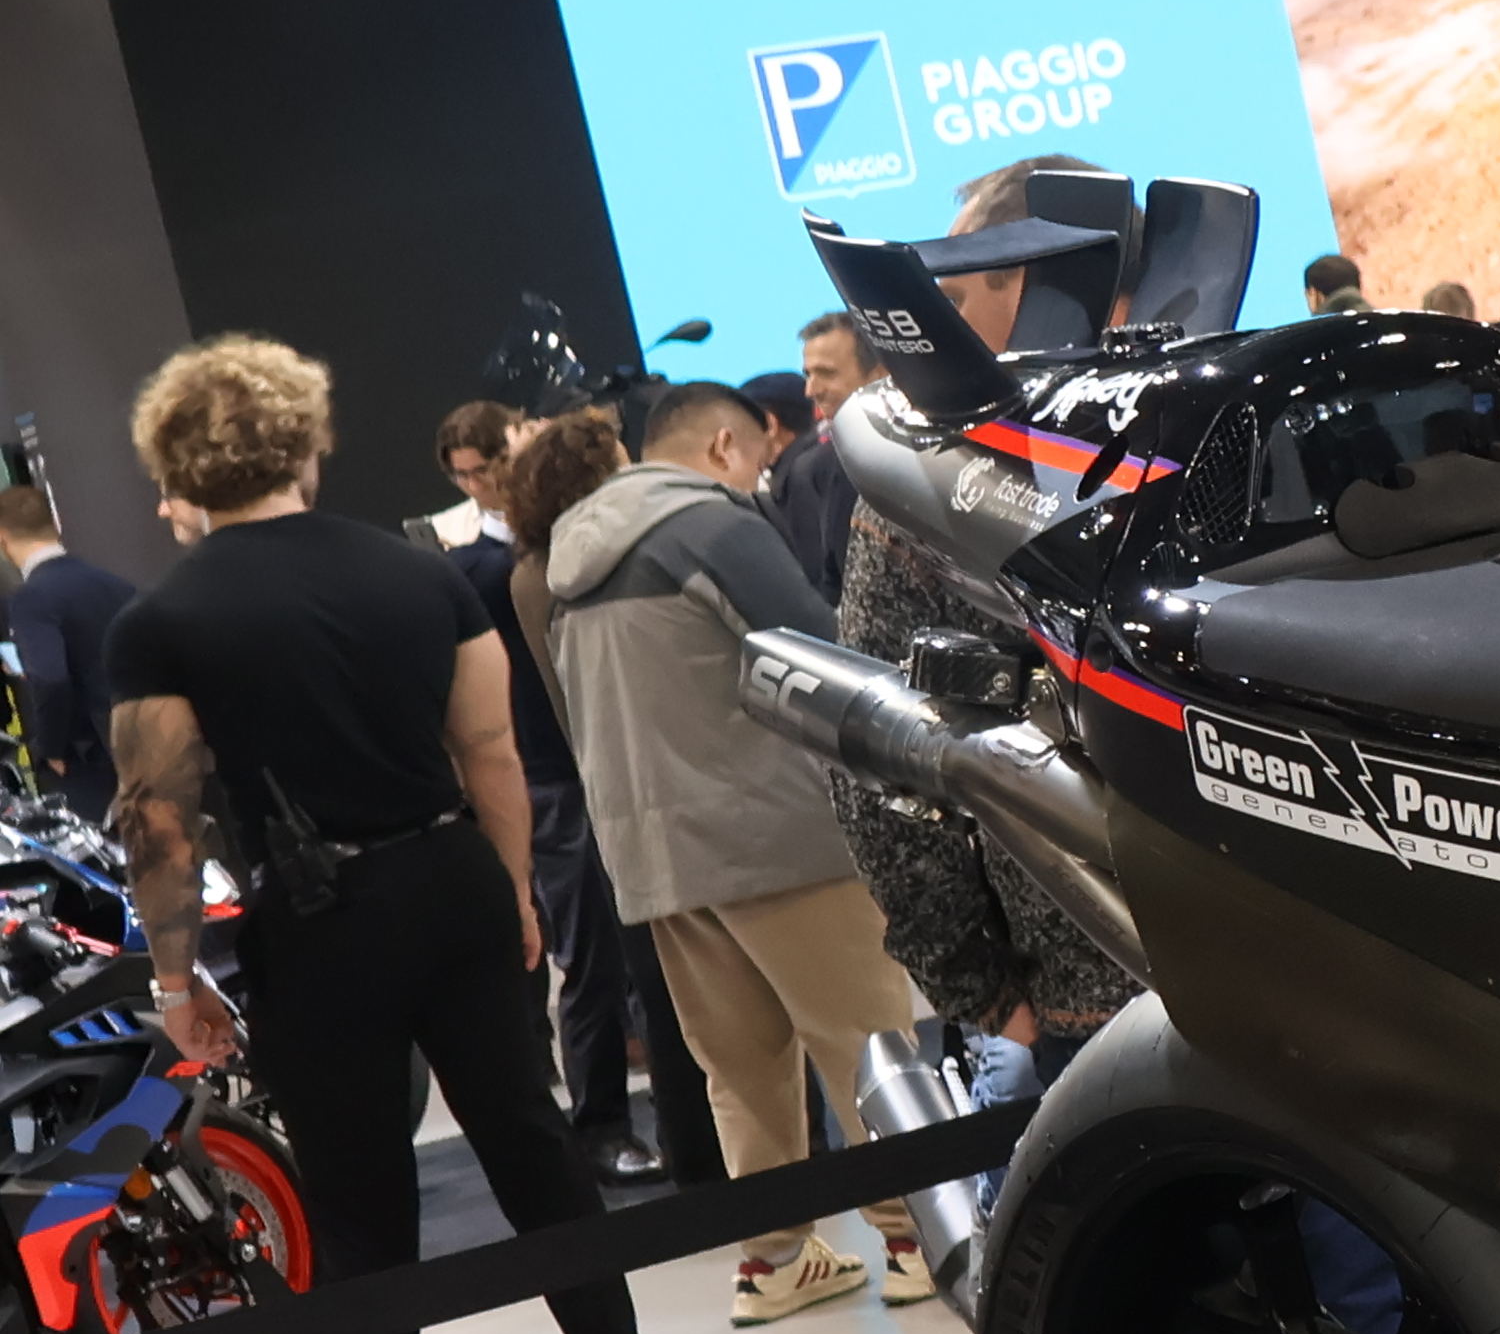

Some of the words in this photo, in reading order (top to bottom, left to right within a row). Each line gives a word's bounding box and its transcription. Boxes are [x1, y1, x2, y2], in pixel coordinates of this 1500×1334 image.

[920, 37, 1127, 104] PIAGGIO
[762, 51, 844, 160] P
[932, 83, 1113, 146] GROUP
[814, 151, 902, 187] PIAGGIO
[1195, 720, 1317, 799] Green
